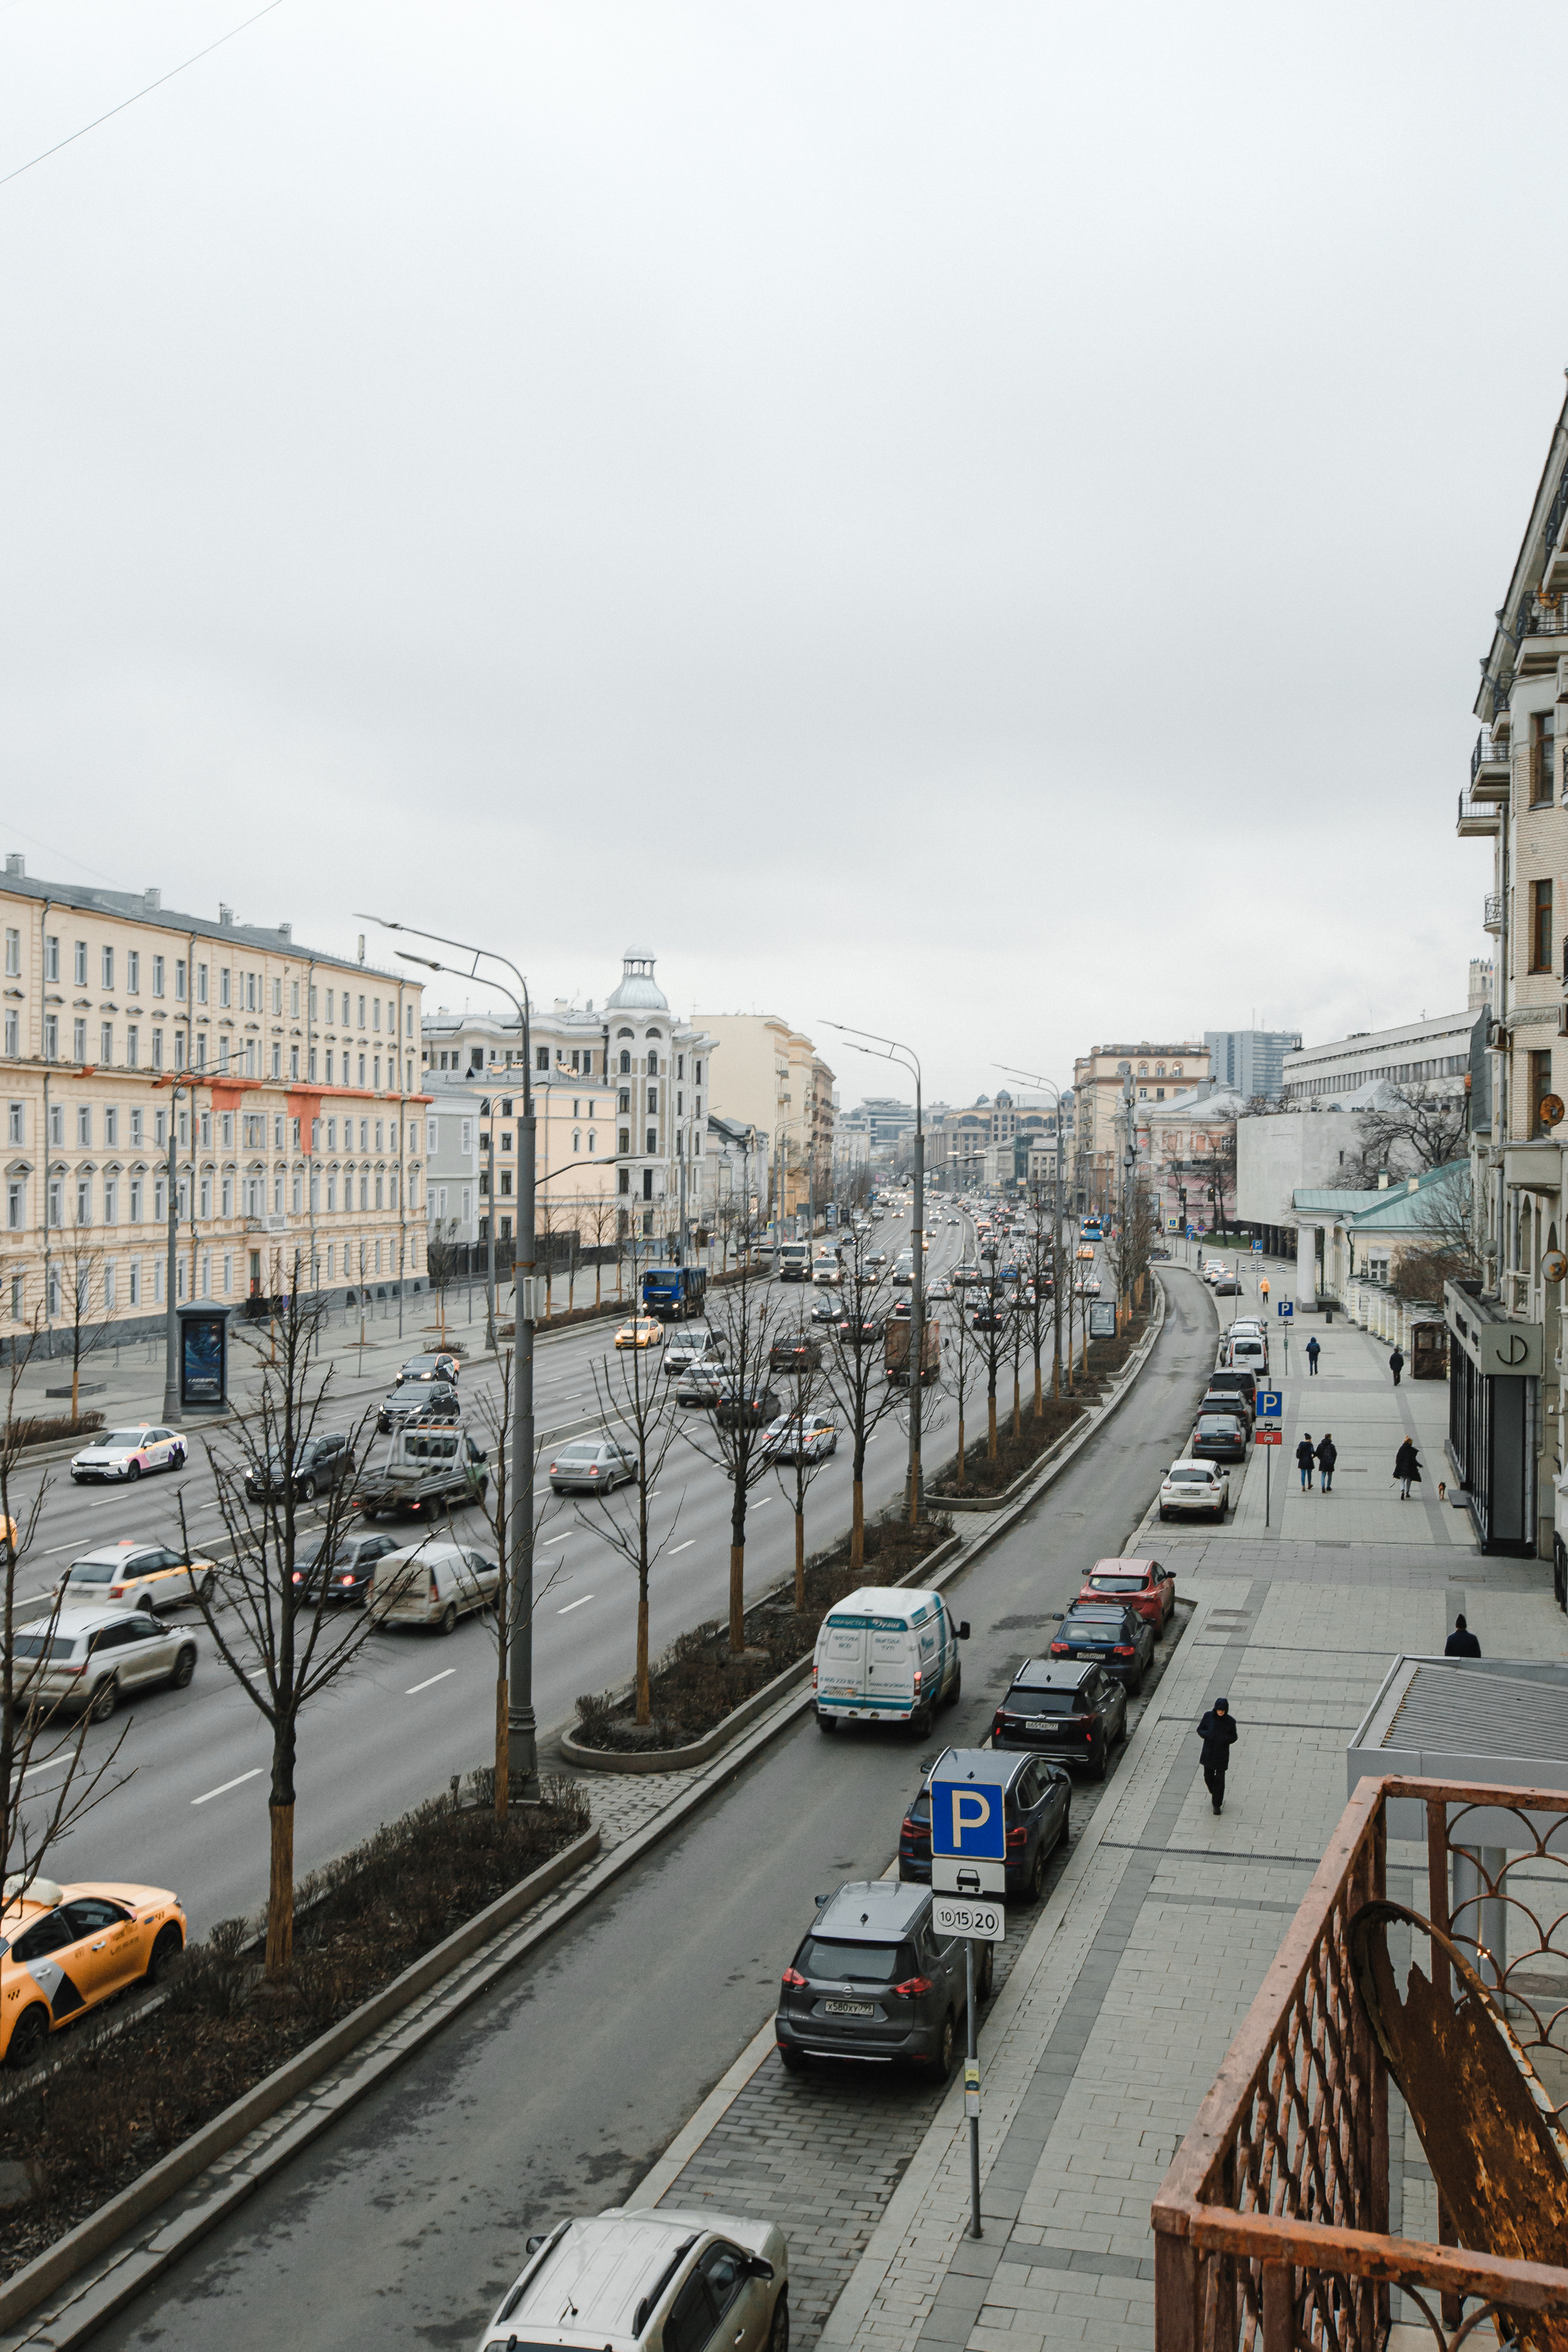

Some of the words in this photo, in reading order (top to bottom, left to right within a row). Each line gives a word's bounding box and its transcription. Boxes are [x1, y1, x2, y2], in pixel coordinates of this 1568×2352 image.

[1281, 1303, 1290, 1315] P
[1263, 1393, 1278, 1414] P
[952, 1790, 990, 1847] P
[940, 1911, 951, 1921] 10
[956, 1912, 969, 1925] 15
[975, 1913, 995, 1929] 20
